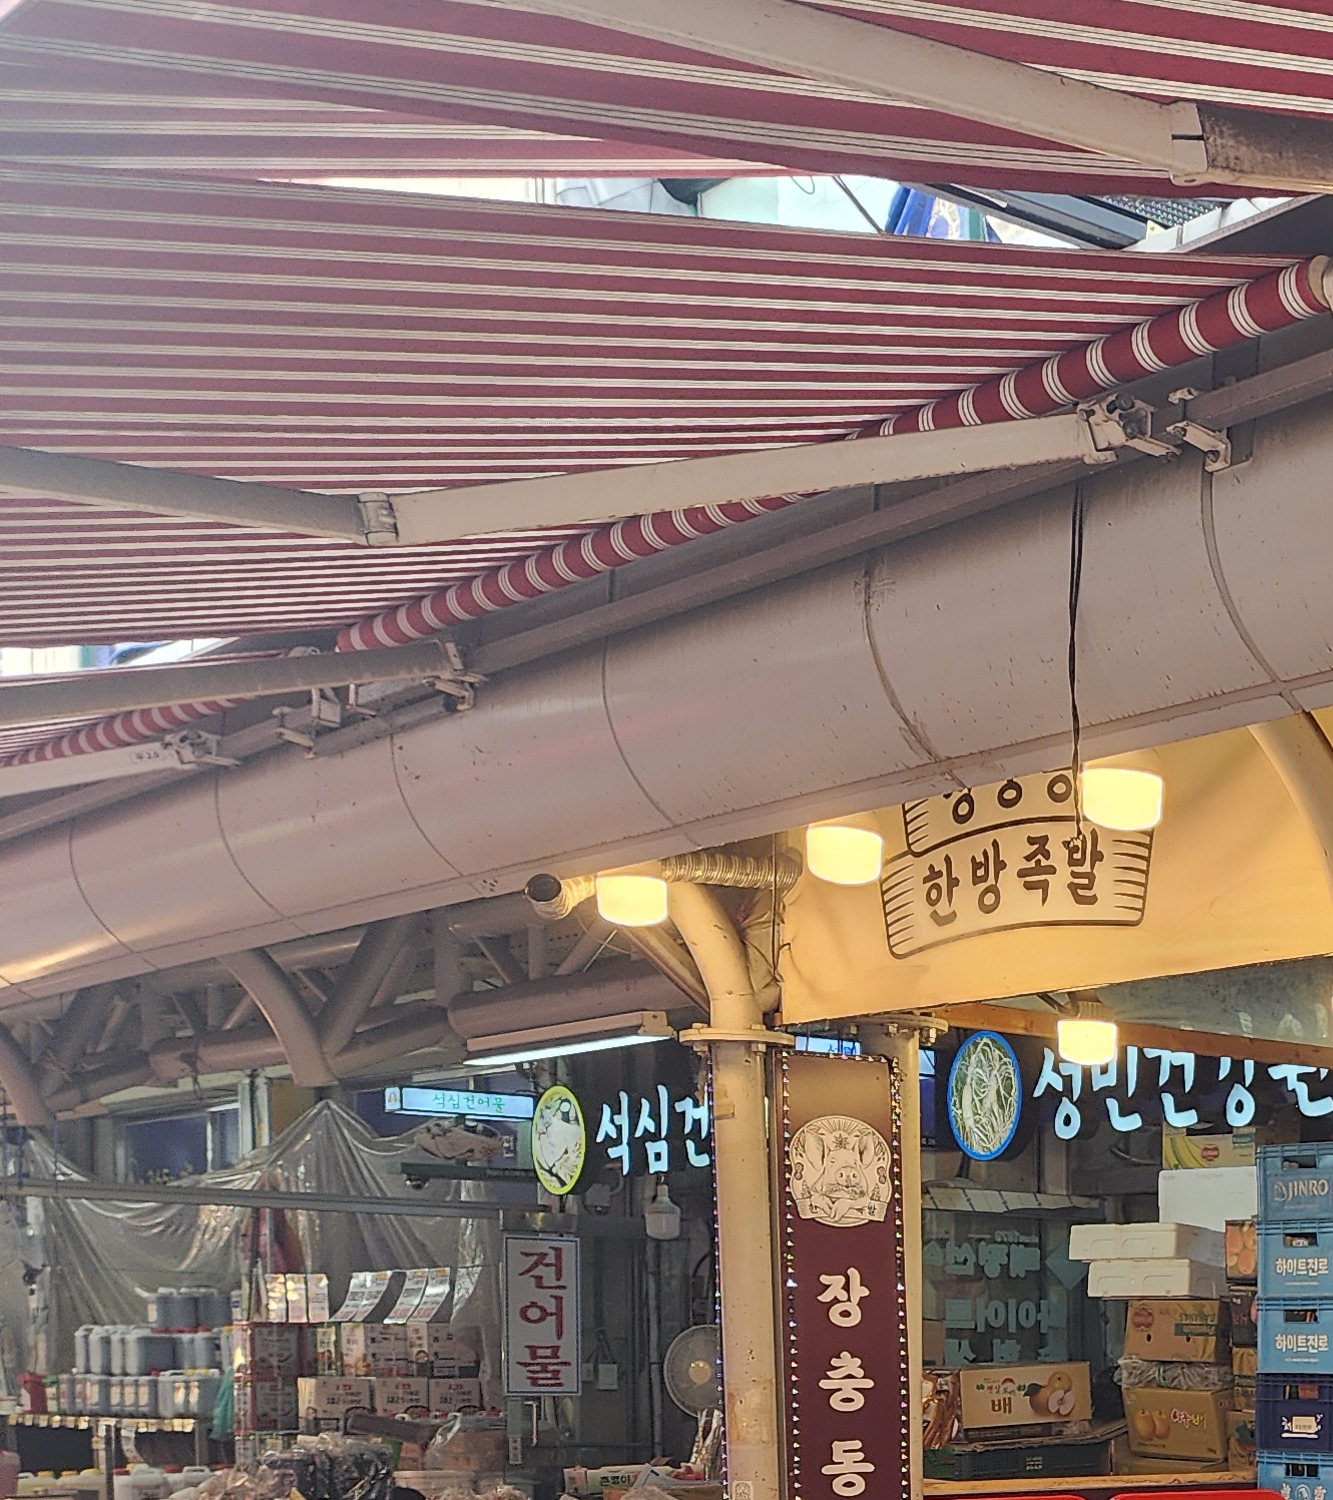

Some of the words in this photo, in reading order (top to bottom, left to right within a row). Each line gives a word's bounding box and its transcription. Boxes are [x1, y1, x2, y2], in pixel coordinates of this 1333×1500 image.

[922, 827, 1105, 928] 한방족발
[1286, 1178, 1330, 1202] JINRO
[1275, 1256, 1330, 1277] 하이트진로
[516, 1246, 573, 1388] 건어물
[1274, 1333, 1330, 1353] 하이트진로
[990, 1397, 1013, 1415] 배
